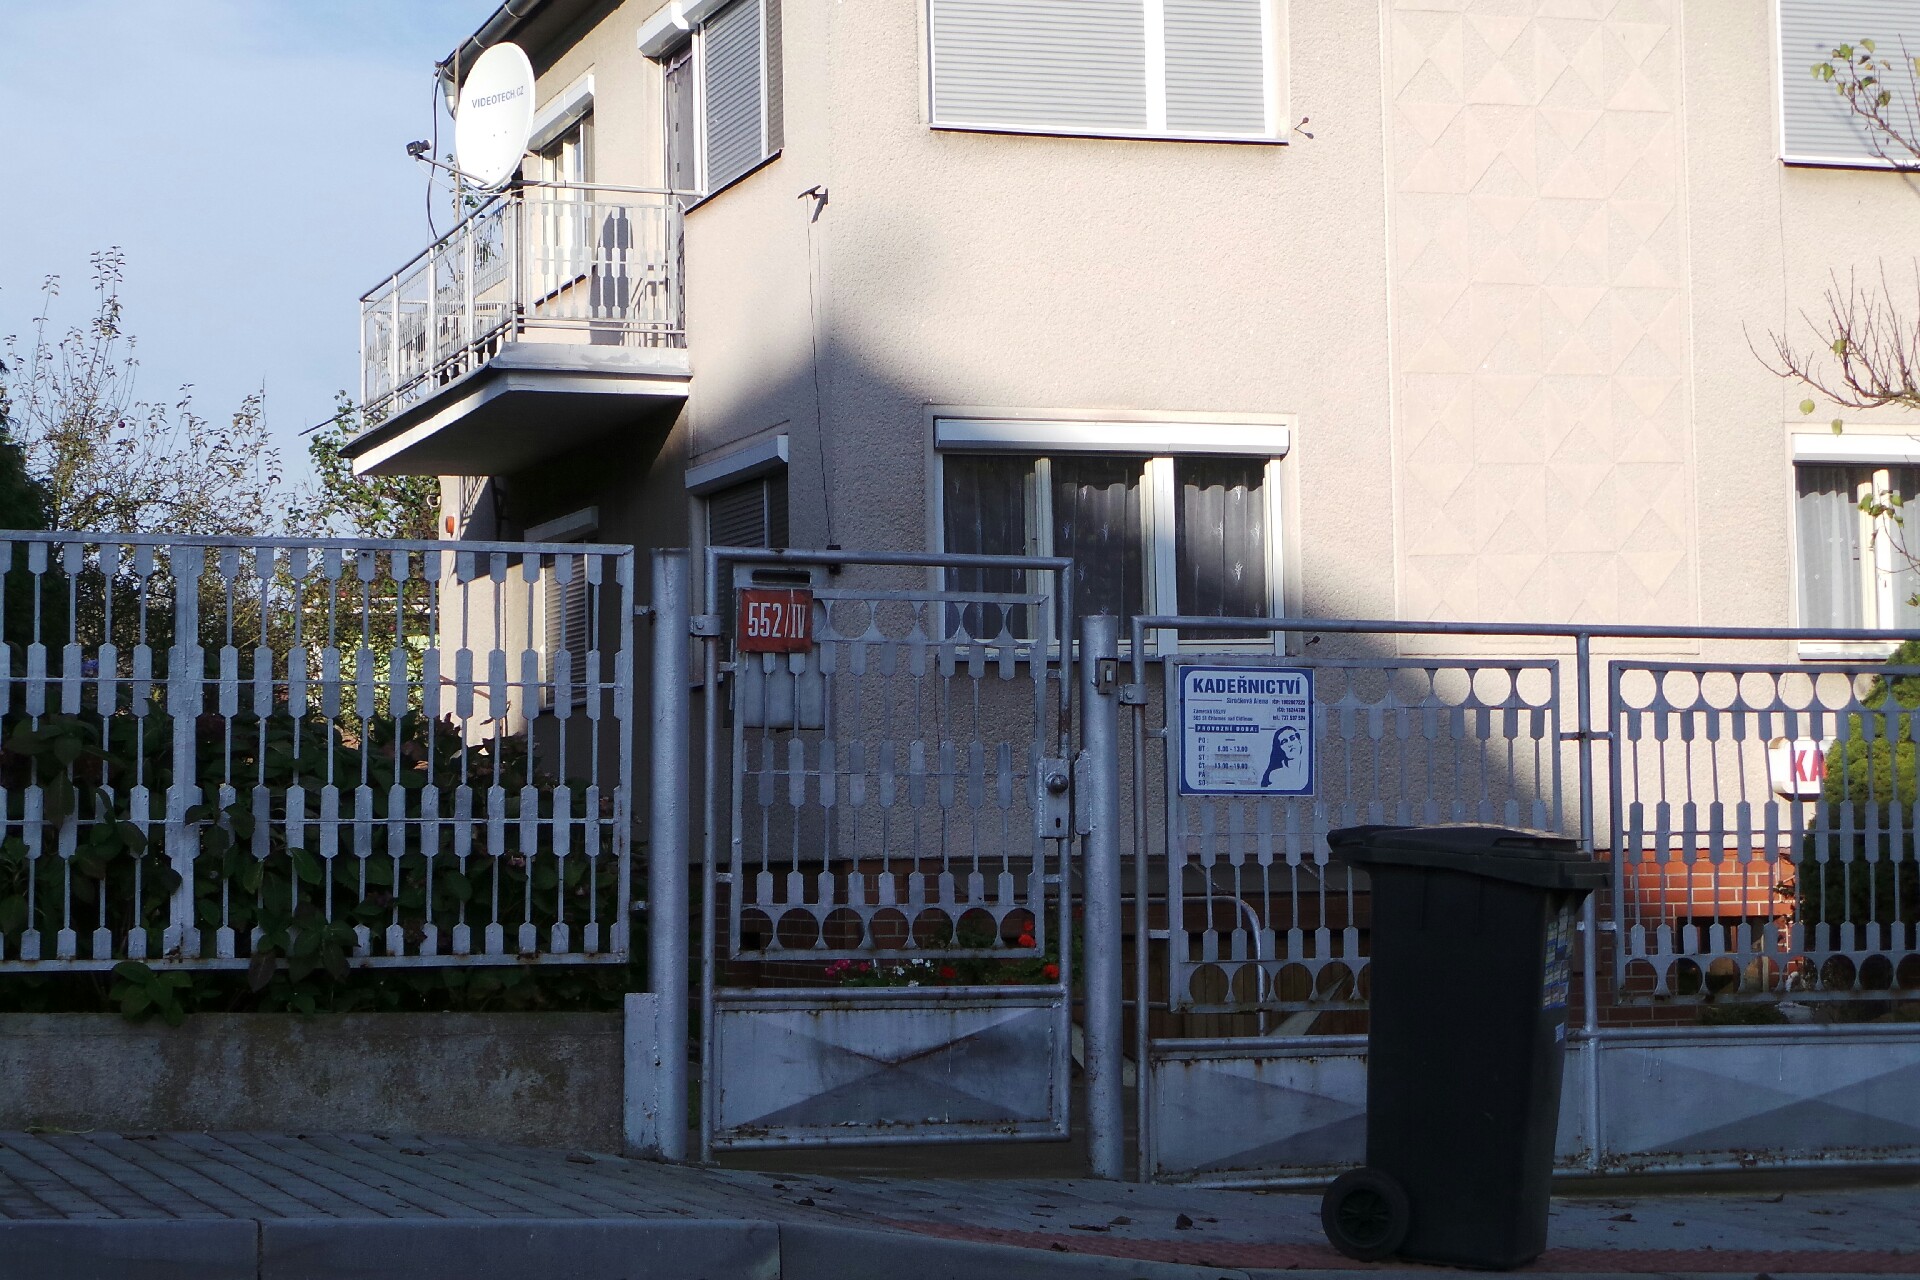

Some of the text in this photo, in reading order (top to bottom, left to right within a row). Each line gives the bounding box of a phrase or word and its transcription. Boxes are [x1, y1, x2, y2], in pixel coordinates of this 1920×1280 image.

[471, 85, 524, 109] VIDEOTECH.CZ
[748, 602, 806, 639] 552/IV
[1193, 675, 1301, 695] KADEŘNICTVÍ
[1235, 725, 1258, 733] DOBA:
